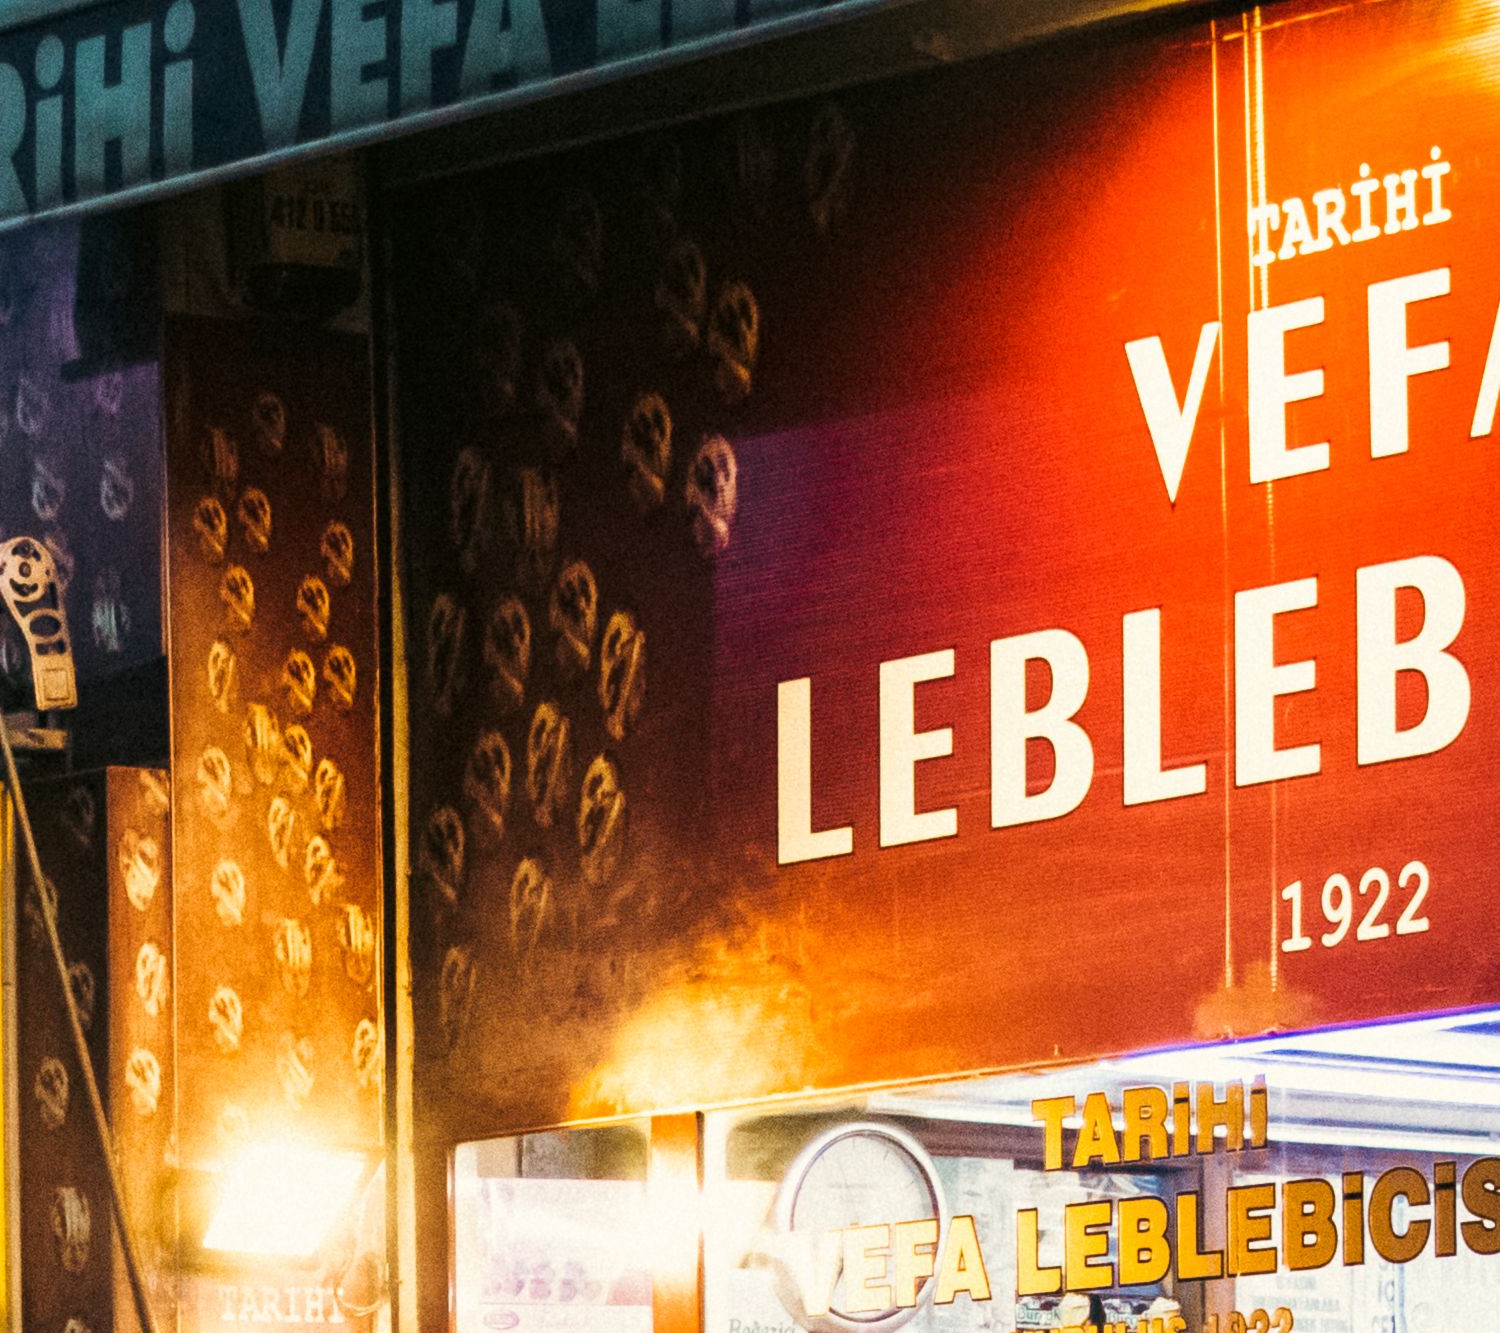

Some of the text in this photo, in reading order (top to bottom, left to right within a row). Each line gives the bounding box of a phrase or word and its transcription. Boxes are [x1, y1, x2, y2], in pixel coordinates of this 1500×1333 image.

[1247, 146, 1452, 267] TARİHİ
[1281, 861, 1430, 954] 1922
[1031, 1074, 1269, 1171] TARİHİ
[798, 1216, 992, 1320] VEFA
